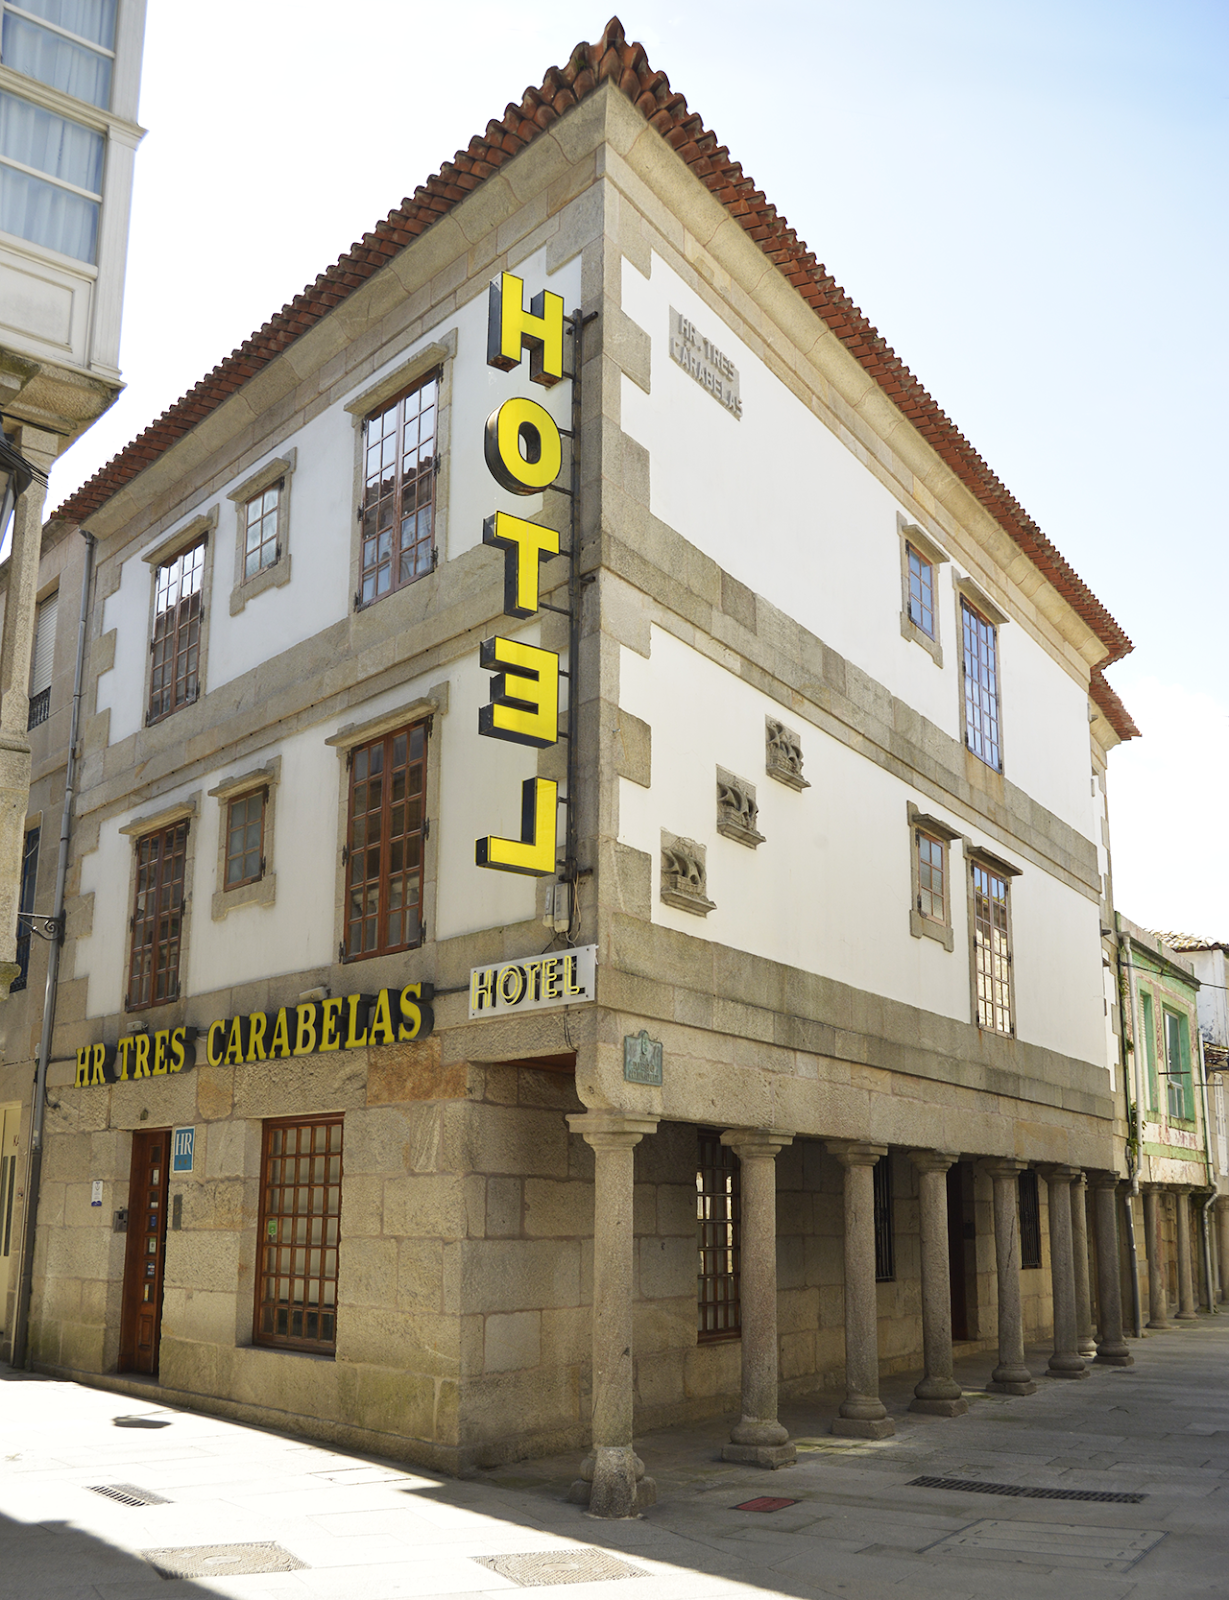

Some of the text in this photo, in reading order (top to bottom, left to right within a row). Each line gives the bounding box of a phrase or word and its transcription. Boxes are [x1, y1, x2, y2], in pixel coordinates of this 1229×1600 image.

[670, 337, 743, 420] CARABELAS
[703, 337, 736, 382] TRES
[471, 955, 585, 1010] HOTEL
[74, 982, 435, 1089] HR TRES CARABELAS
[175, 1132, 192, 1156] HR
